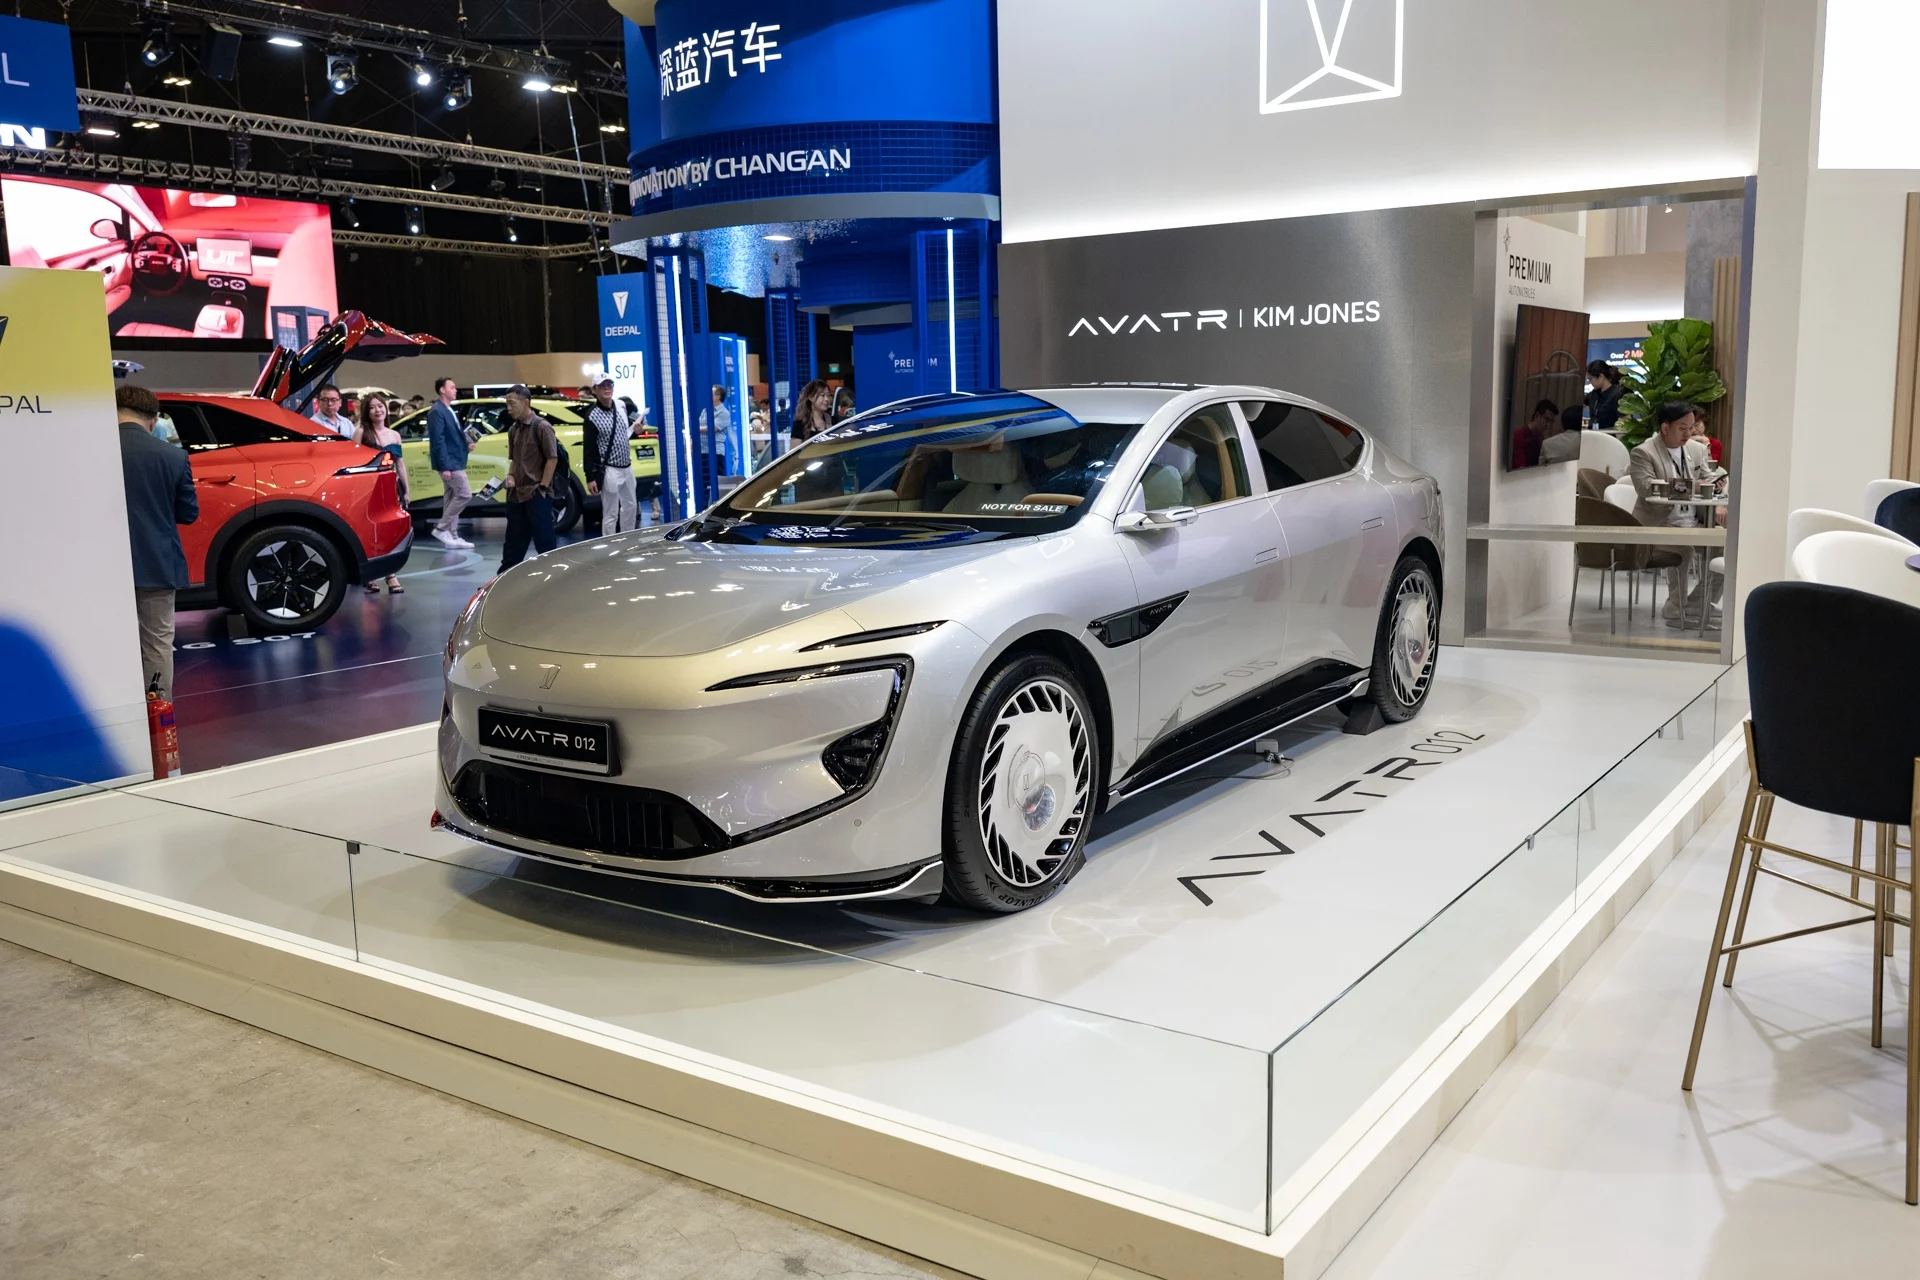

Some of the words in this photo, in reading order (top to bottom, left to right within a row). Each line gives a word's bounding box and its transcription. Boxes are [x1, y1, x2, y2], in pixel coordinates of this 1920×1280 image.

[659, 22, 782, 100] 深蓝汽车
[691, 160, 711, 184] BY
[715, 149, 851, 180] CHANGAN
[1508, 254, 1551, 285] PREMIUM
[1068, 309, 1228, 337] AVATR
[1254, 305, 1294, 328] KIM
[1299, 300, 1381, 326] JONES
[605, 325, 641, 337] DEEPAL
[614, 364, 637, 380] S07
[1149, 603, 1172, 616] AVATR
[232, 631, 316, 645] S07
[491, 724, 569, 747] AVATR
[574, 736, 596, 751] 012
[1410, 730, 1486, 754] 012
[998, 893, 1043, 907] DUNLOP
